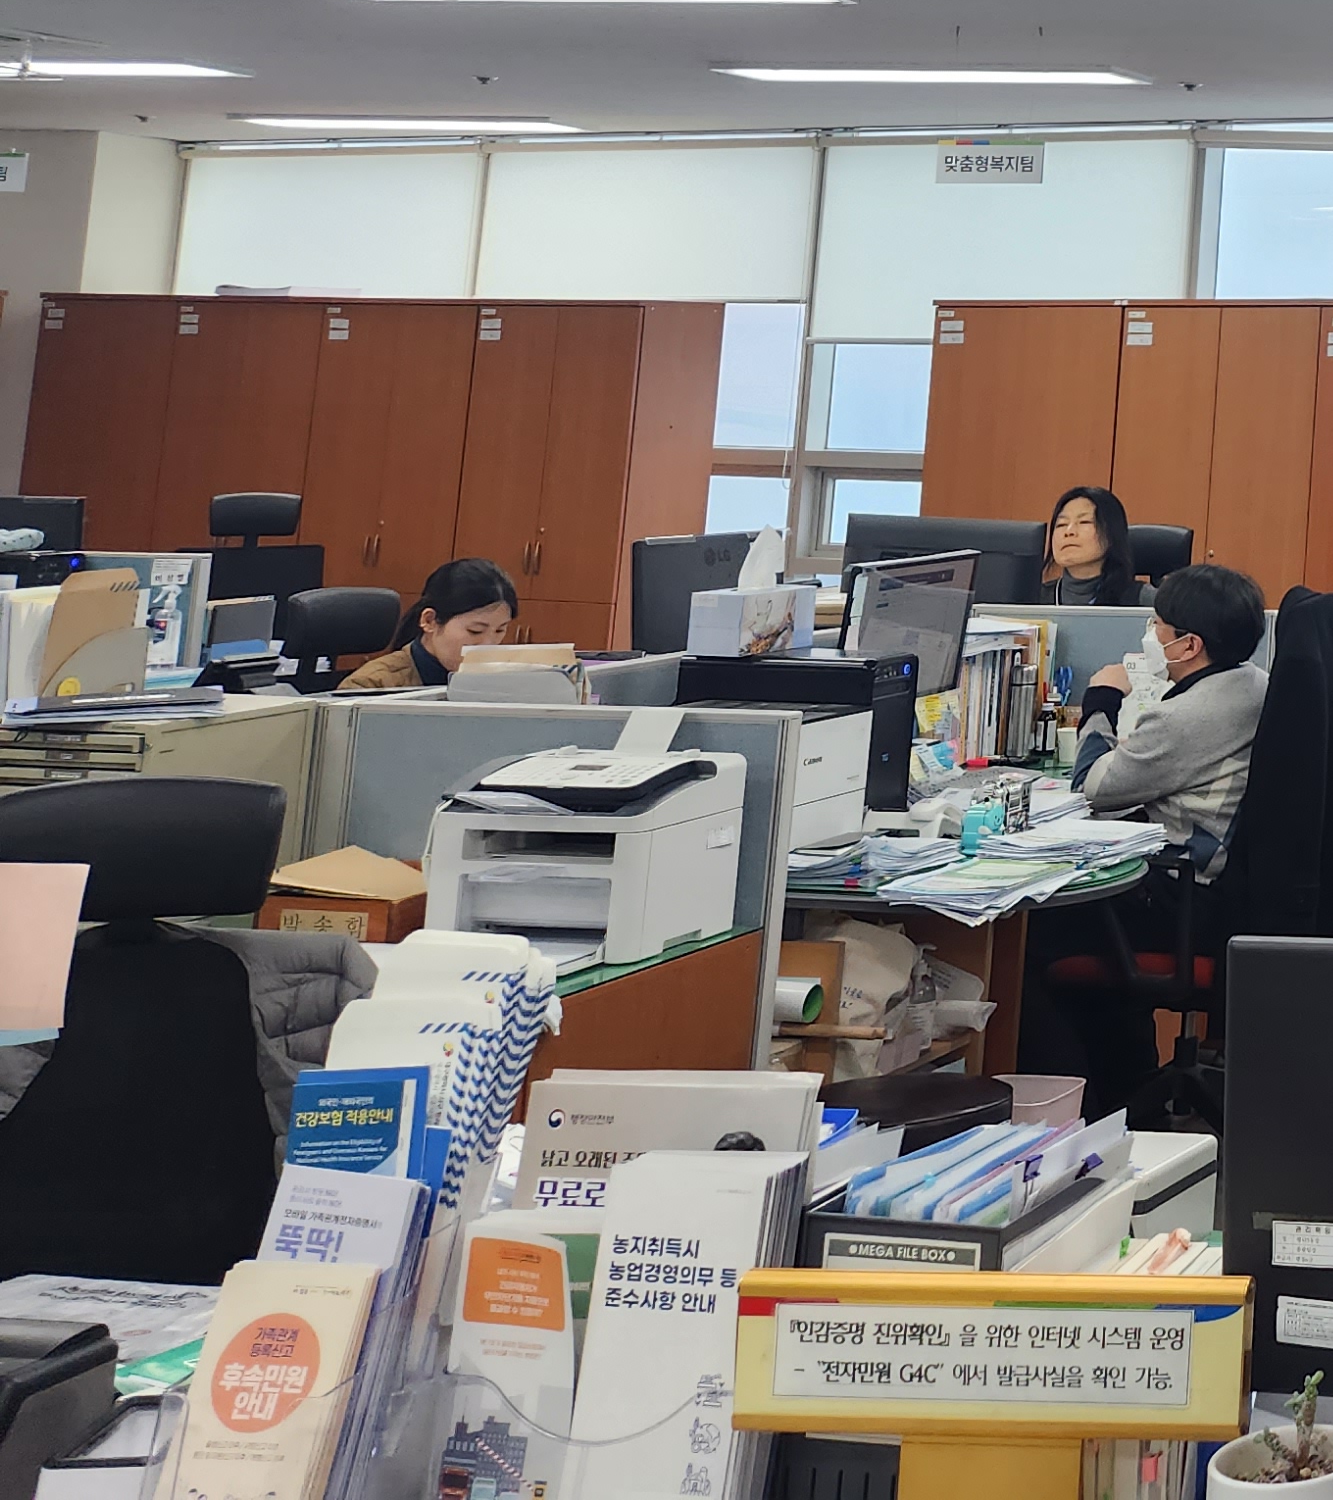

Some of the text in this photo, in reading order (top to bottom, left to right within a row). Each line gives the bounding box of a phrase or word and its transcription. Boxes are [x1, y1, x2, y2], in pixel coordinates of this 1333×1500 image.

[944, 155, 1034, 173] 맞춤형복지팀
[296, 1108, 394, 1128] 건강보험 적용안내
[541, 1149, 570, 1168] 낡고
[572, 1150, 618, 1169] 오래된
[535, 1179, 607, 1208] 무료로
[275, 1223, 345, 1263] 뚝딱!
[612, 1234, 700, 1259] 농지취득시
[858, 1244, 945, 1262] MEGA FILE BOX
[609, 1261, 714, 1286] 농업경영의무
[605, 1287, 676, 1311] 준수사항
[682, 1292, 716, 1314] 안내
[959, 1323, 978, 1348] 을
[985, 1324, 1021, 1349] 위한
[1028, 1325, 1082, 1350] 인터넷
[1088, 1327, 1142, 1351] 시스템
[1150, 1327, 1184, 1351] 운영
[218, 1362, 308, 1394] 후속민원
[953, 1364, 988, 1387] 에서
[998, 1364, 1083, 1389] 발급사실을
[1091, 1367, 1127, 1390] 확인
[231, 1391, 279, 1421] 안내
